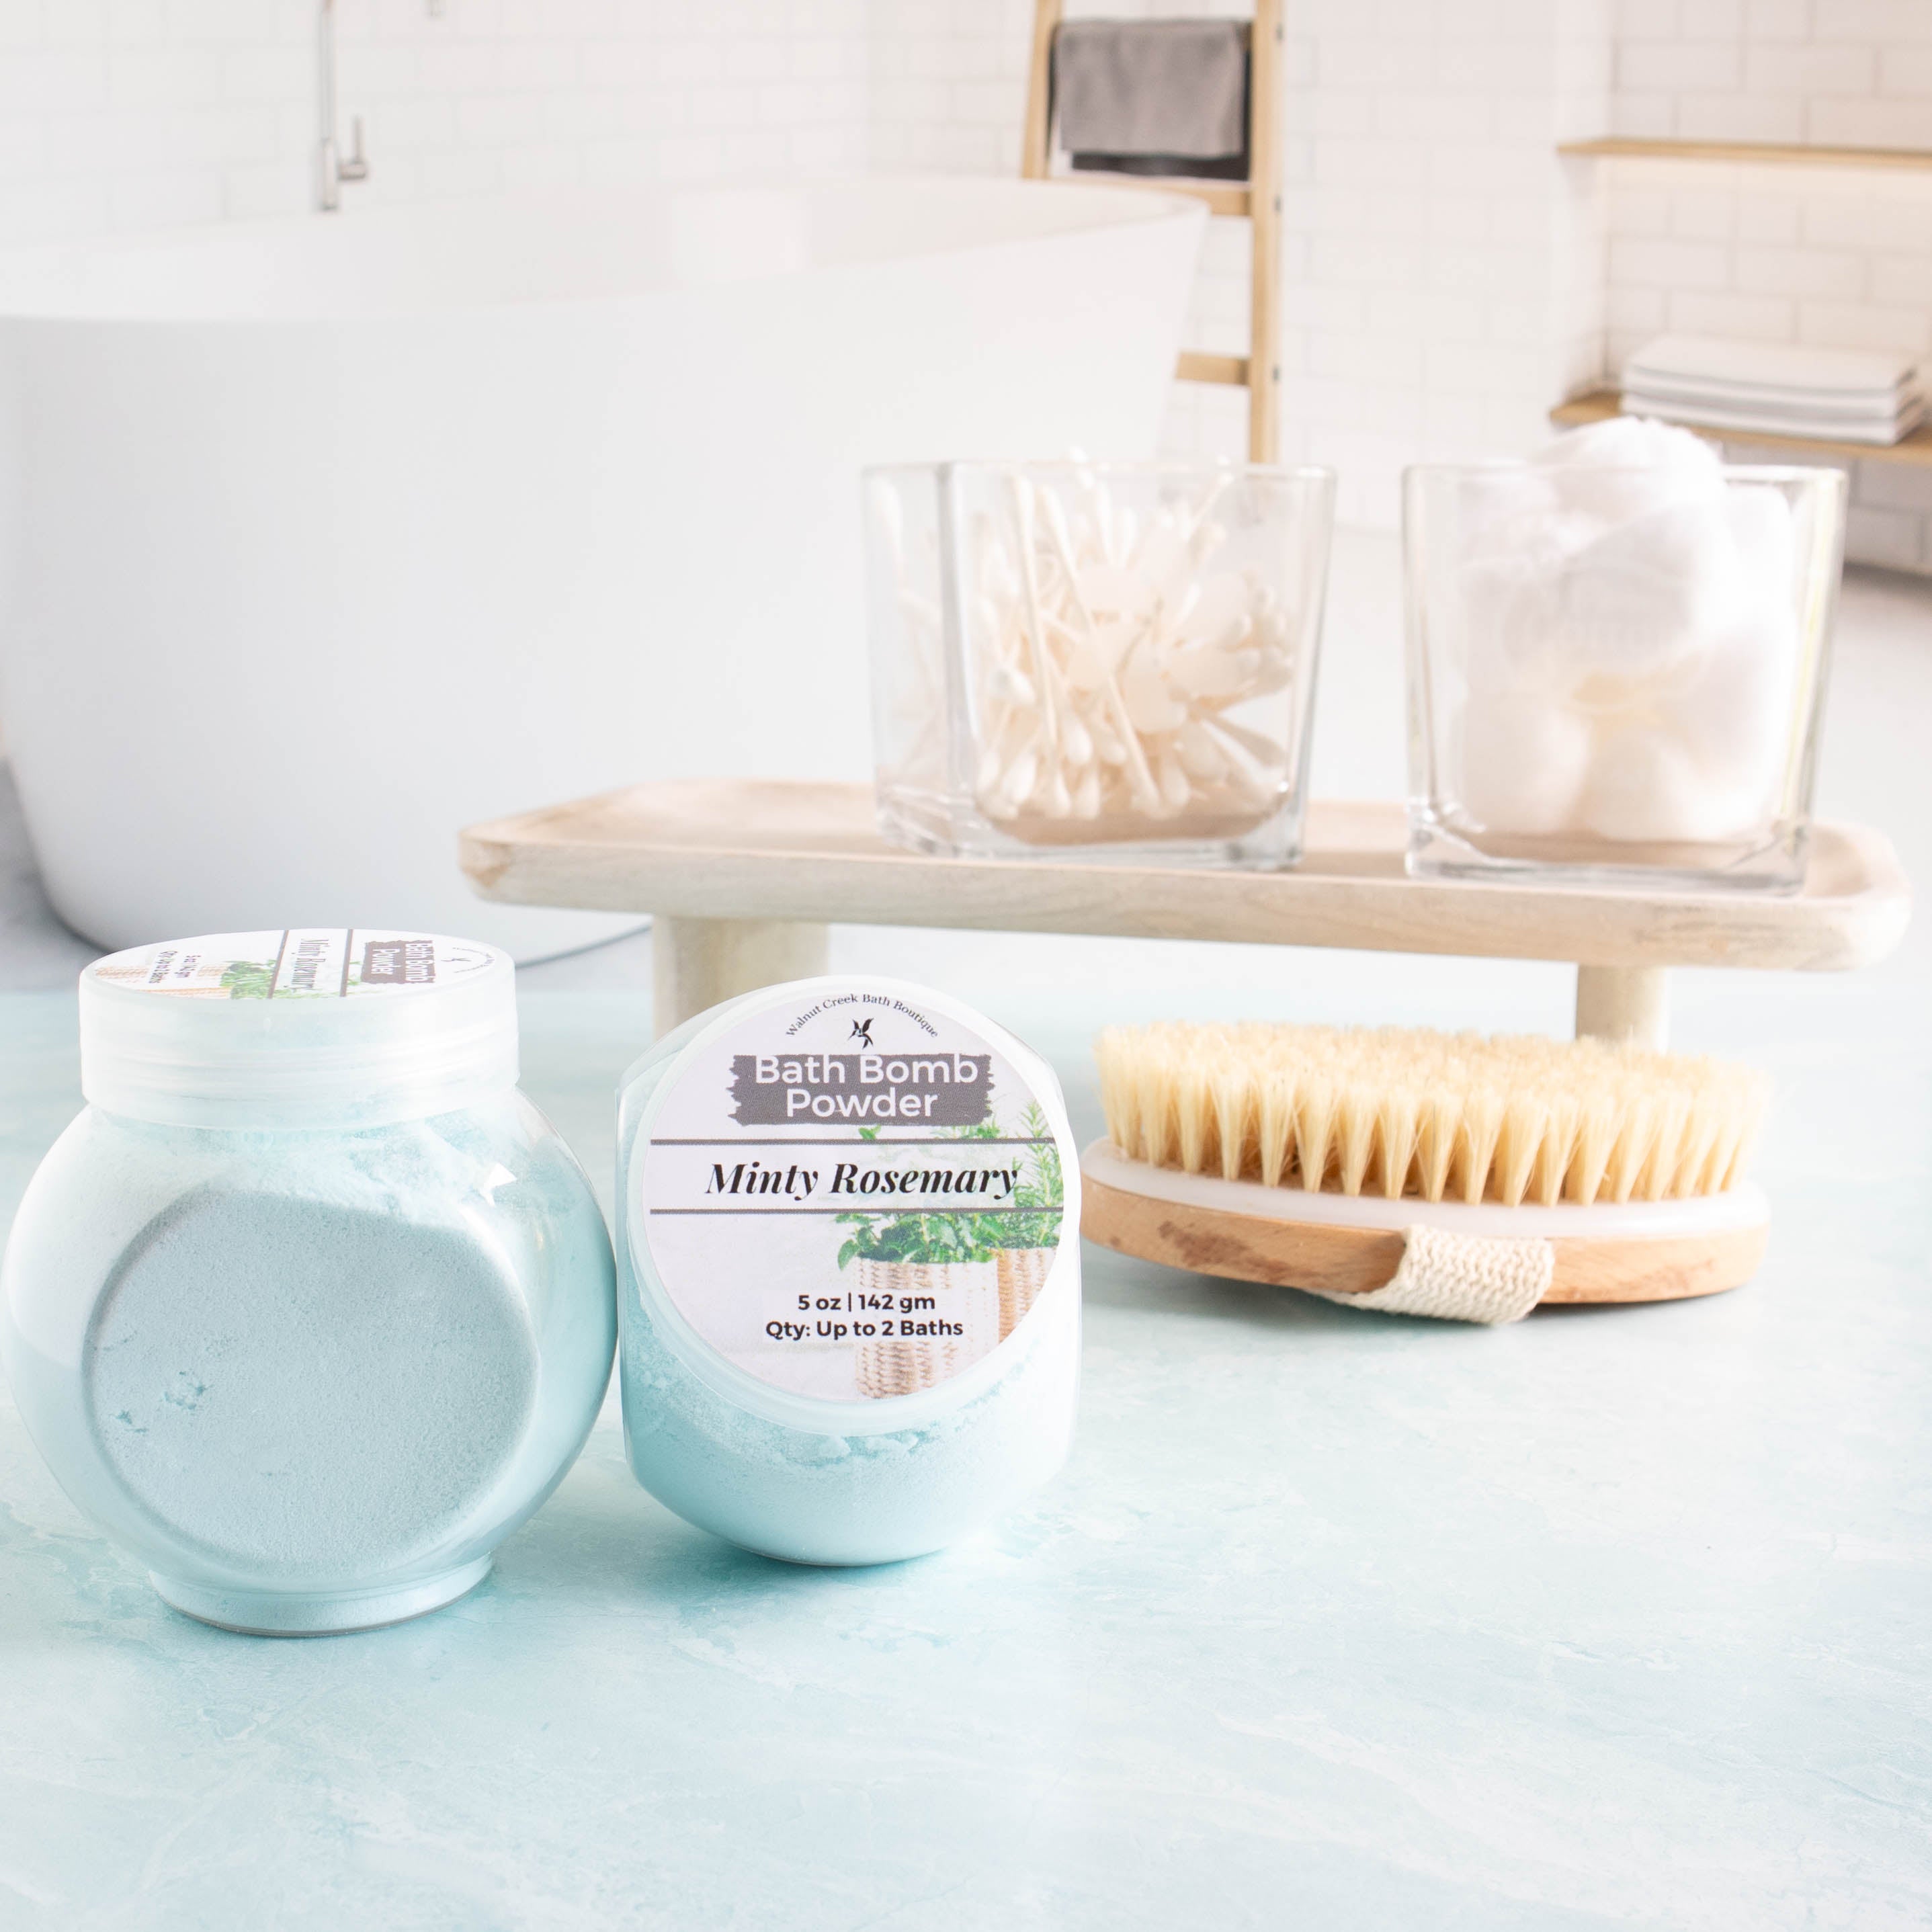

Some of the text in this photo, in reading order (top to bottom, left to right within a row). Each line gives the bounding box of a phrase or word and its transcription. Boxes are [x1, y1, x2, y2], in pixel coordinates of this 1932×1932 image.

[371, 948, 401, 974] Powder
[405, 943, 435, 981] Bath Bomb
[786, 993, 938, 1038] Walnut Creek Bath Boutique
[755, 1053, 978, 1084] Bath Bomb
[786, 1087, 939, 1118] Powder
[704, 1161, 1018, 1201] Minty Rosemary
[798, 1294, 810, 1310] 5
[815, 1298, 842, 1310] oz
[857, 1294, 894, 1310] 142
[899, 1297, 936, 1314] gm
[765, 1319, 964, 1341] Qty: Up to 2 Baths
